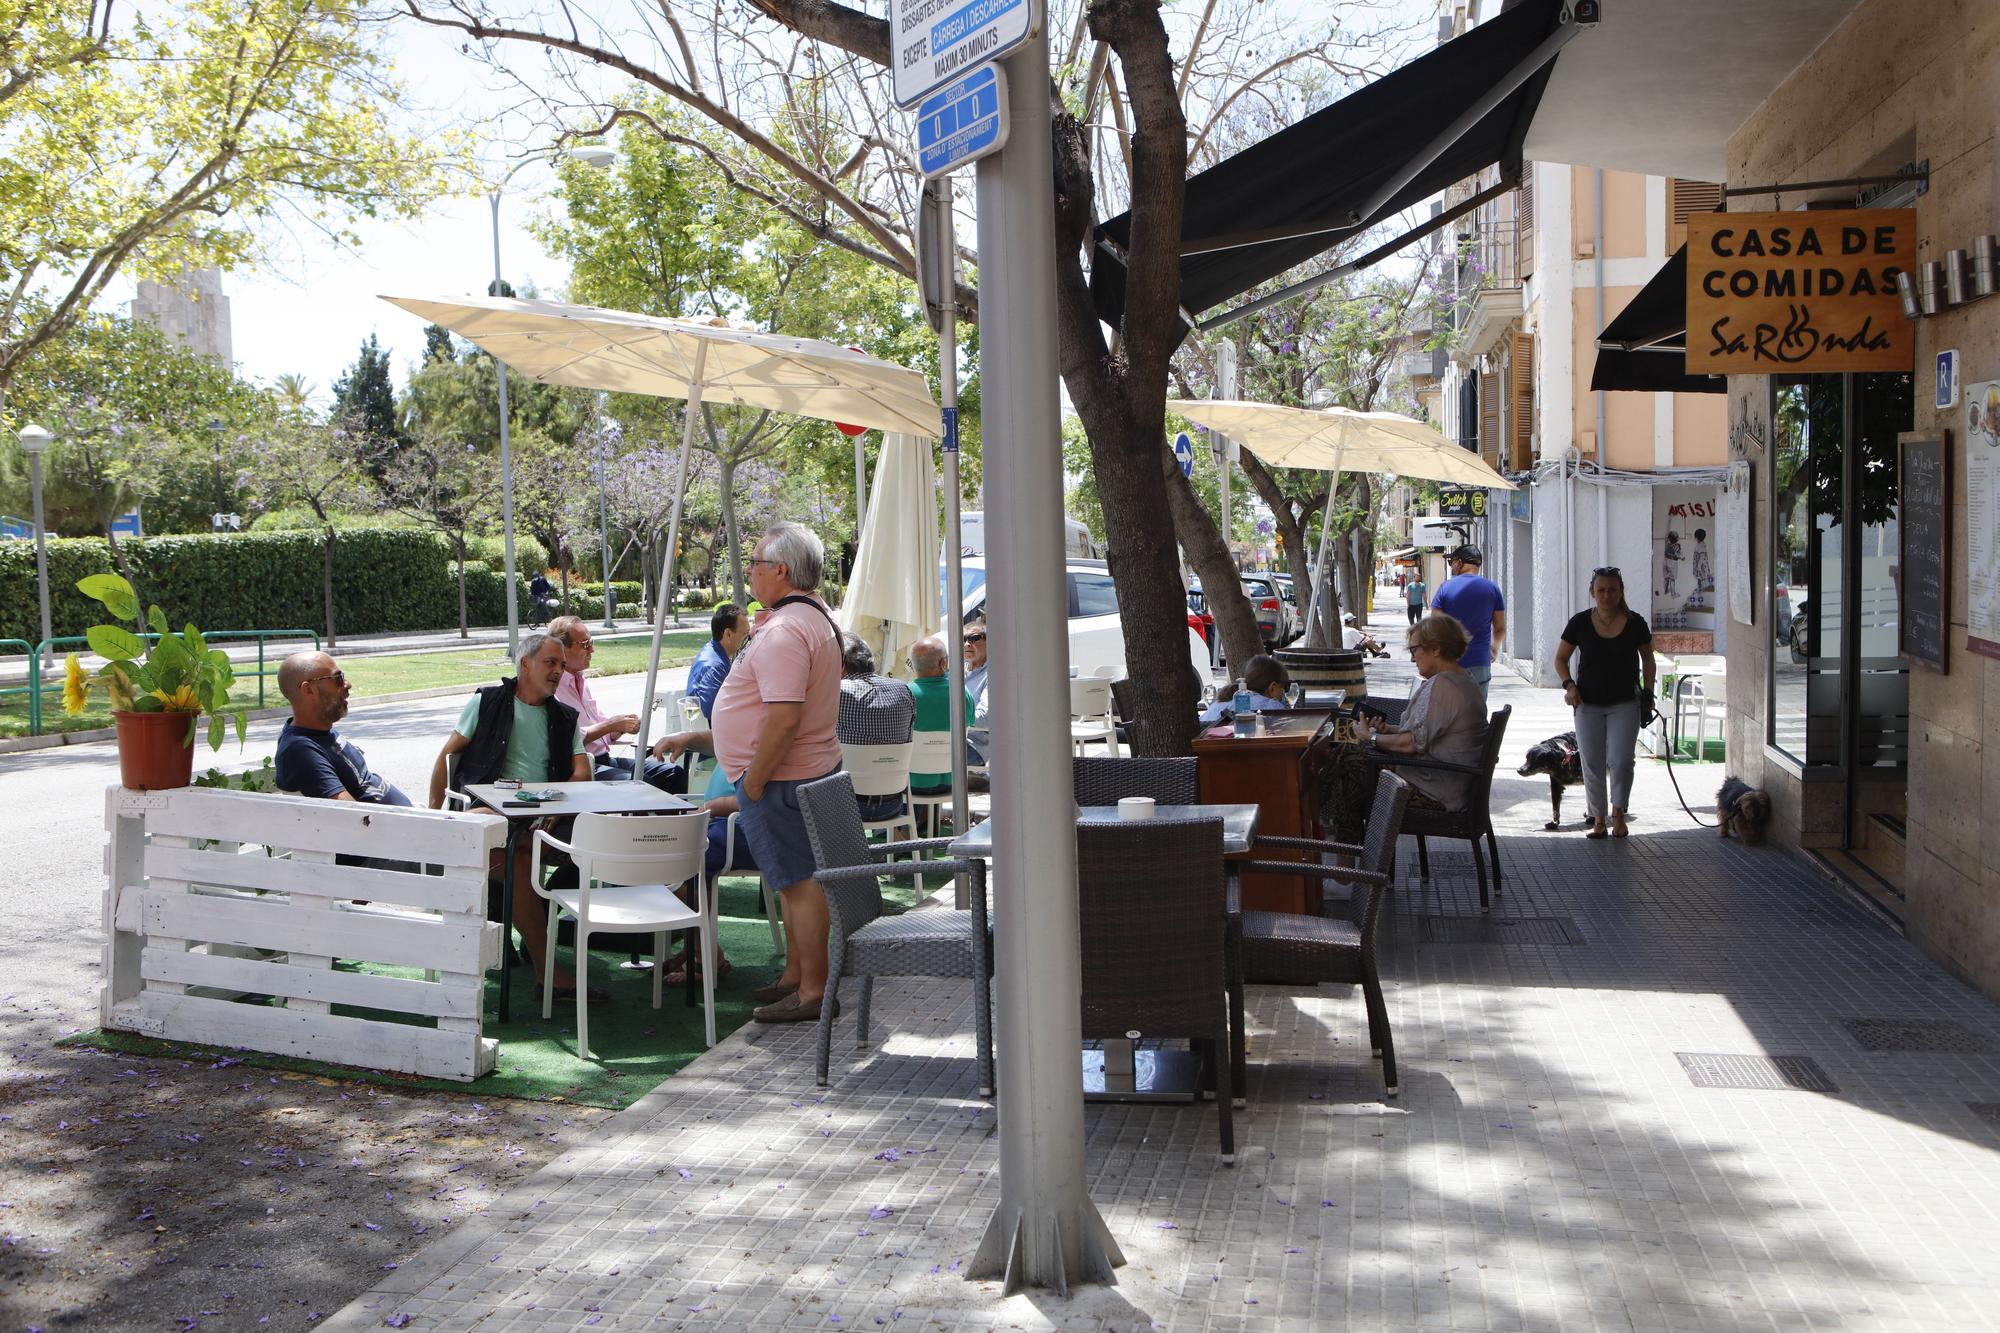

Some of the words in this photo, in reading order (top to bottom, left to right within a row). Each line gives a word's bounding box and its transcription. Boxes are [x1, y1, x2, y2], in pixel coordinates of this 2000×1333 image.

[902, 0, 936, 34] DISSABTES
[903, 37, 927, 69] EXCEPTE
[933, 16, 966, 50] CÀRREGA
[934, 53, 958, 79] MÀXIM
[959, 45, 968, 64] 30
[968, 27, 998, 59] MINUTS
[946, 83, 966, 104] SECTOR
[935, 115, 942, 139] 0
[972, 94, 980, 119] 0
[1711, 227, 1823, 257] CASA
[1842, 226, 1896, 255] DE
[1702, 267, 1902, 298] COMIDAS
[1940, 361, 1948, 389] R
[1441, 491, 1467, 507] Switch
[1668, 504, 1688, 518] ART
